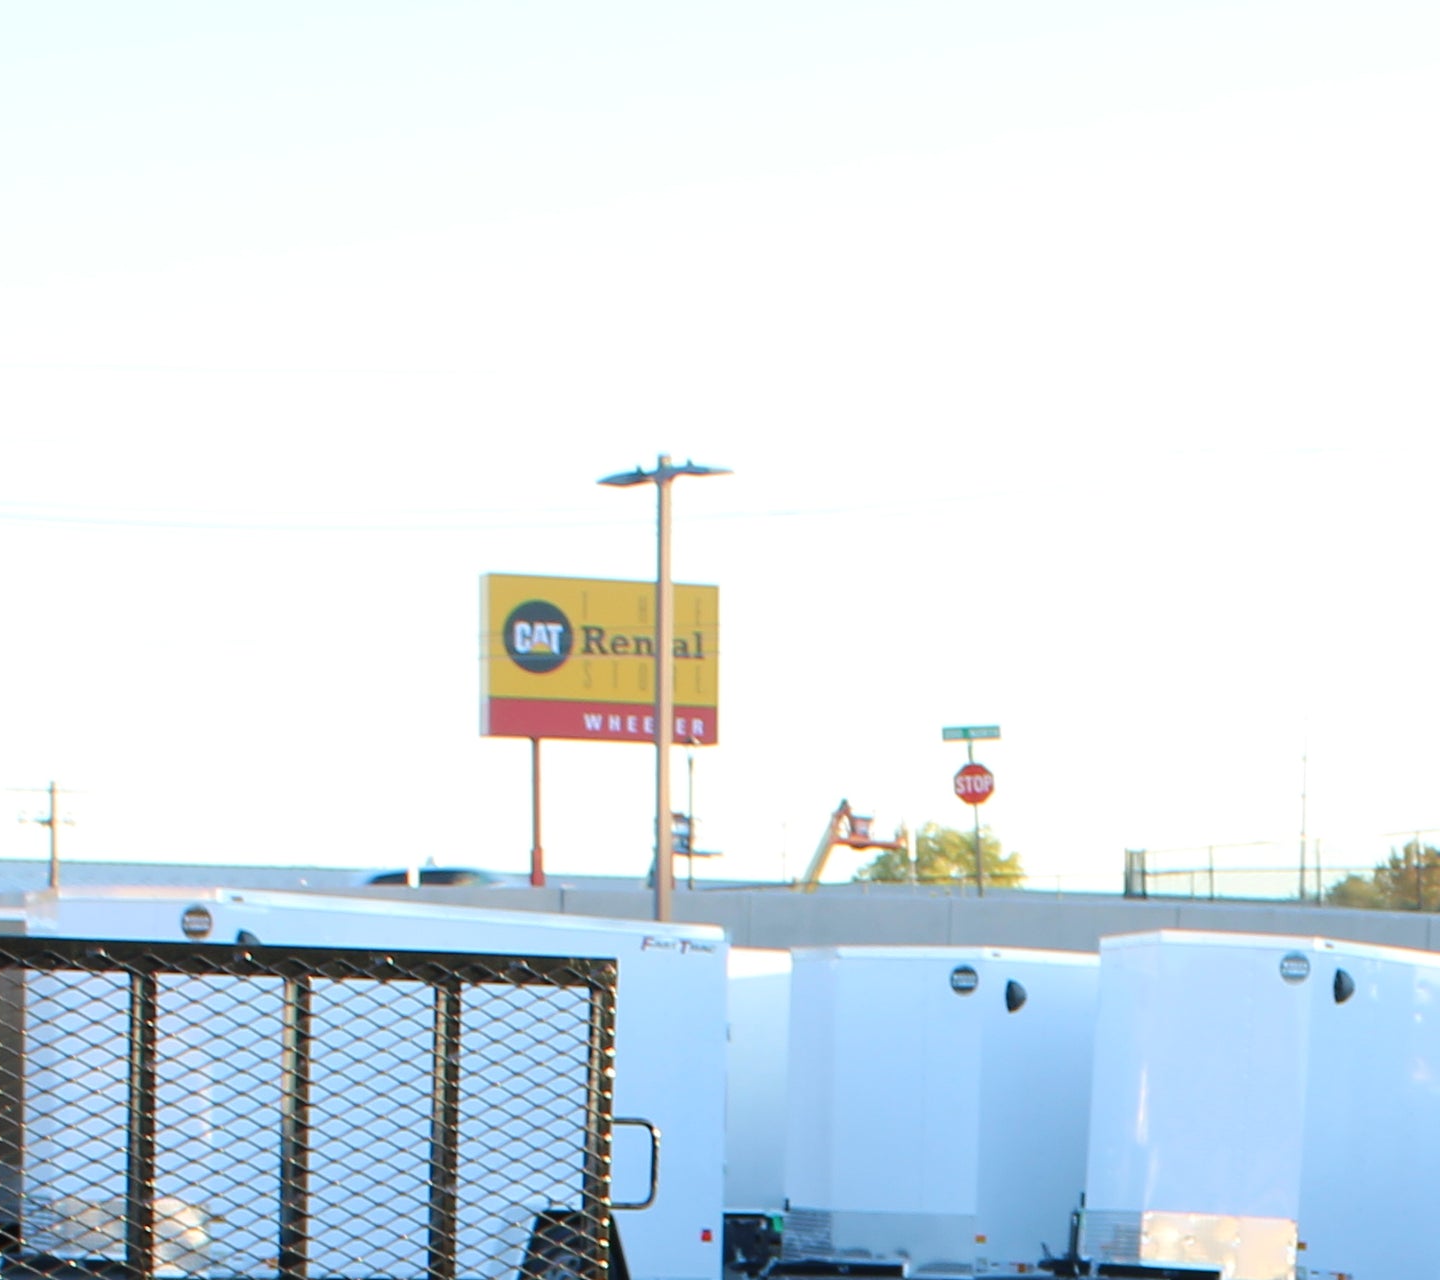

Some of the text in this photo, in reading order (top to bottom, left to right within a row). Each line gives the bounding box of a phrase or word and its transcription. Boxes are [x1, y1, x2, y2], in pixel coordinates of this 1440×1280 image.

[514, 620, 565, 656] CAT
[580, 625, 705, 660] Renal
[583, 660, 703, 694] STOE
[583, 713, 705, 737] WHEEER
[956, 775, 993, 794] STOP
